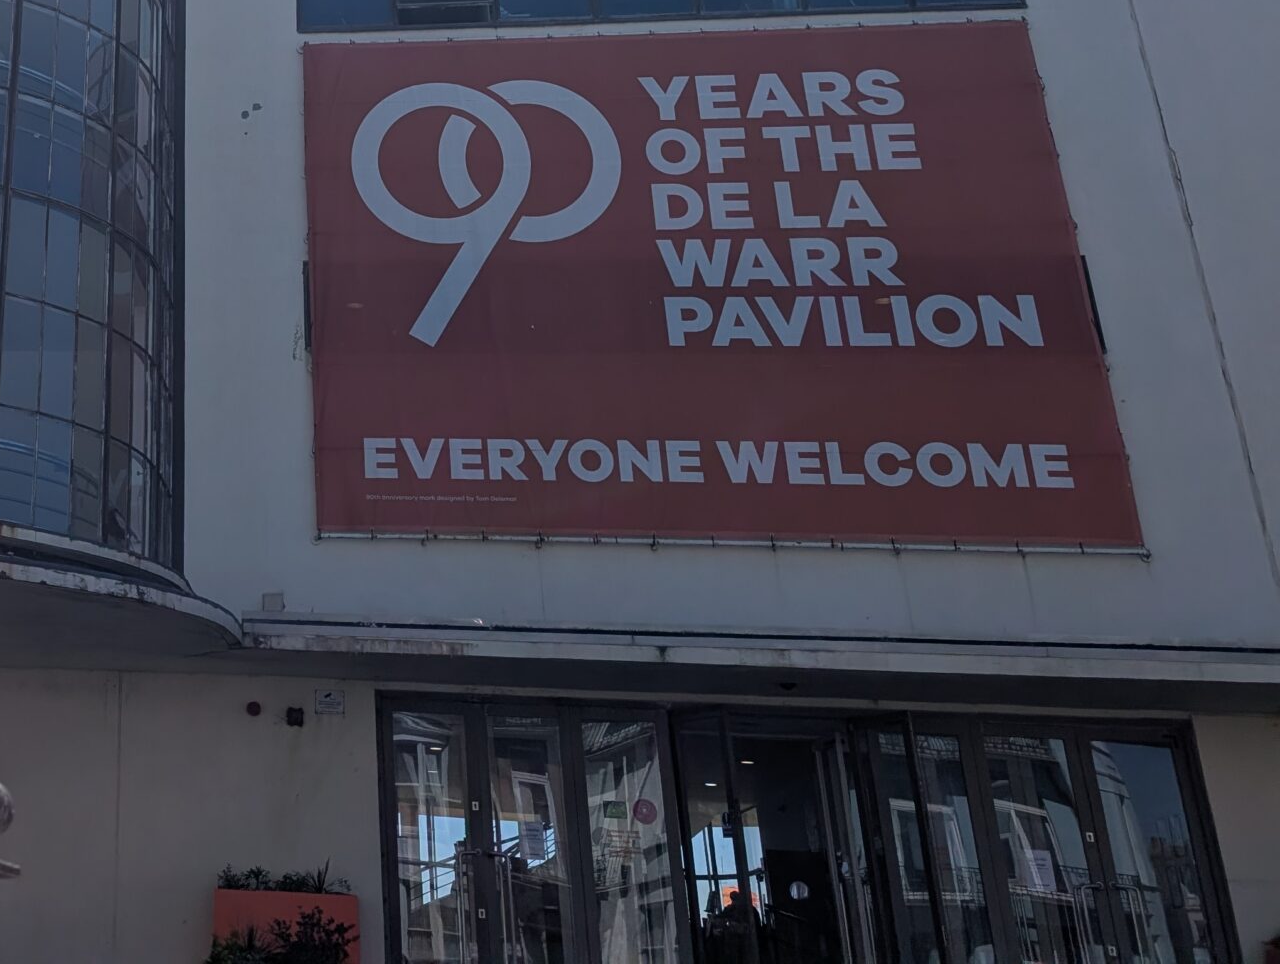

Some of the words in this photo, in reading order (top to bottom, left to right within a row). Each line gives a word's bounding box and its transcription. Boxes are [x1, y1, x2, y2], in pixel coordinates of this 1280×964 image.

[638, 69, 904, 120] YEARS
[646, 128, 745, 175] OF
[762, 124, 921, 172] THE
[352, 80, 621, 346] 90
[651, 183, 754, 230] DE
[774, 180, 887, 228] LA
[656, 237, 904, 286] WARR
[664, 295, 1043, 347] PAVILION
[364, 438, 704, 482] EVERYONE
[716, 441, 1074, 487] WELCOME
